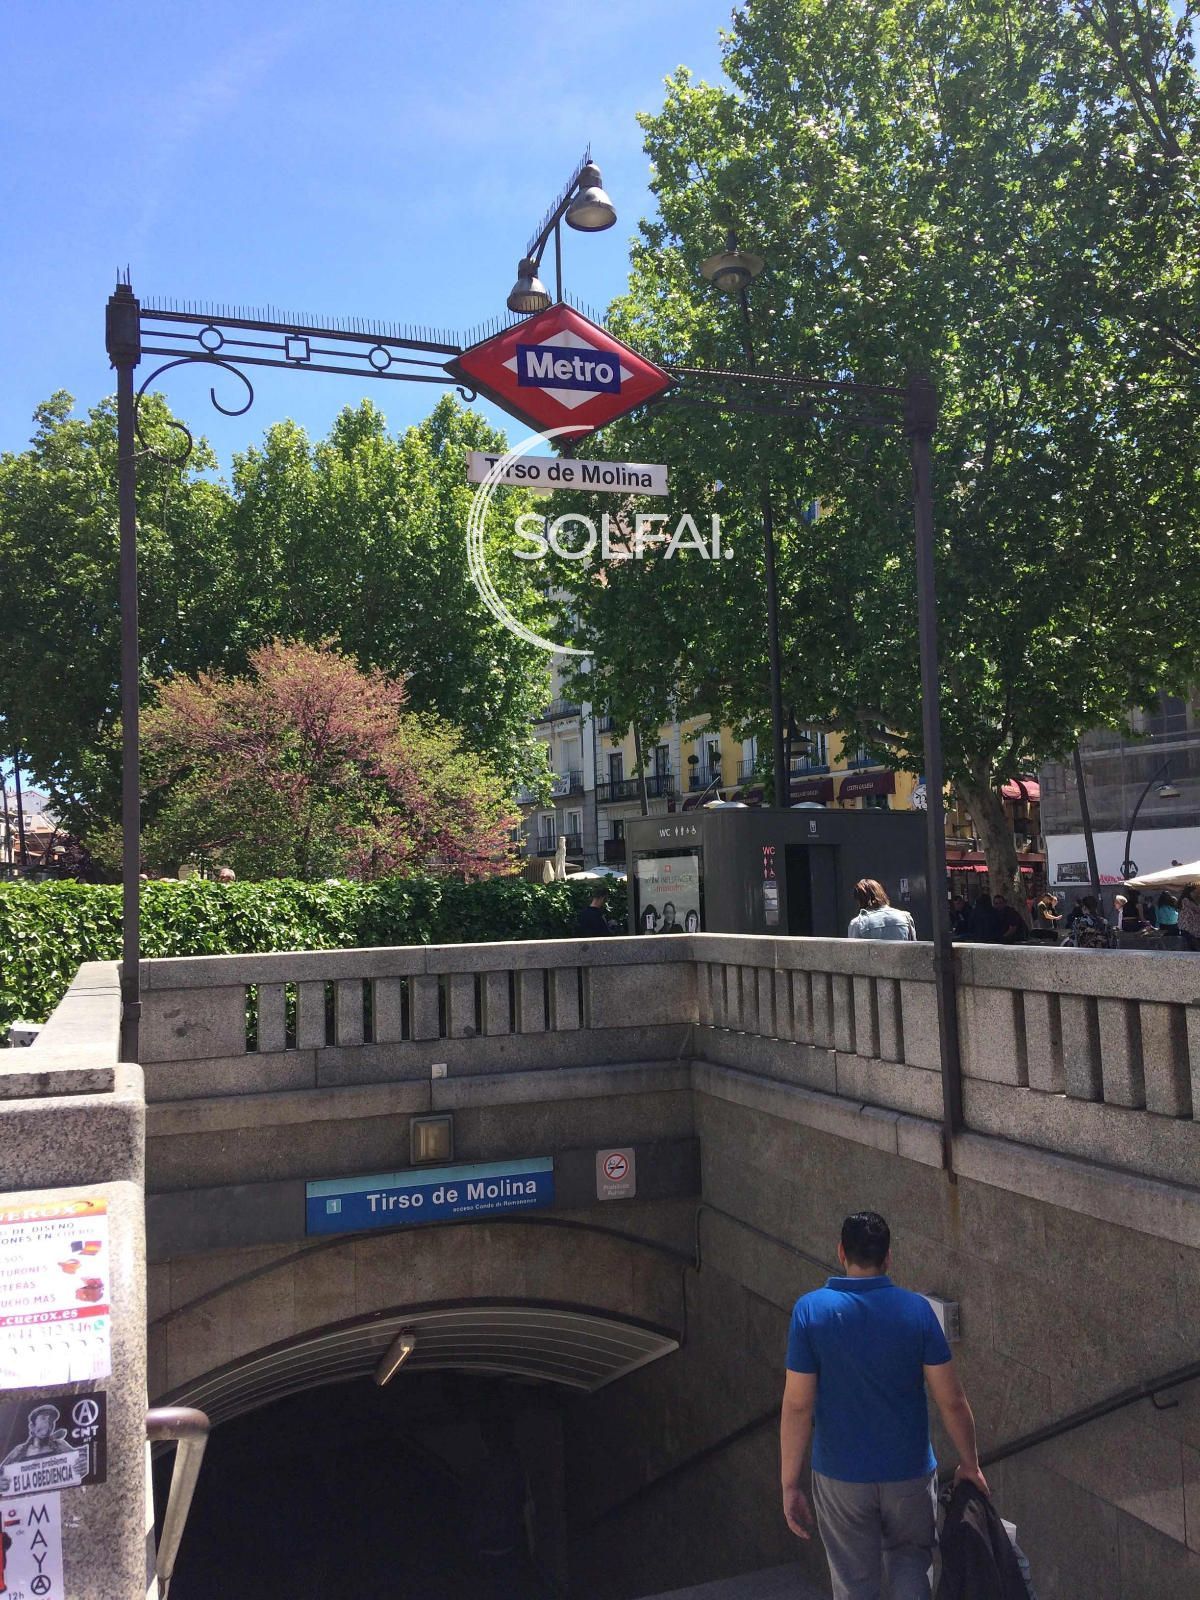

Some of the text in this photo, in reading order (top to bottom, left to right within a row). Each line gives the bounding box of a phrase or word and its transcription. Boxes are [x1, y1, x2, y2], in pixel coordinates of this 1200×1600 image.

[526, 351, 614, 384] Metro
[485, 457, 653, 488] Tirso de Molina
[659, 828, 671, 838] WC
[762, 846, 776, 855] WC
[366, 1180, 537, 1212] Tirso de Molina
[37, 1233, 52, 1241] EN
[71, 1425, 99, 1438] CNT
[13, 1464, 73, 1492] ES LA OBEDIENCIA
